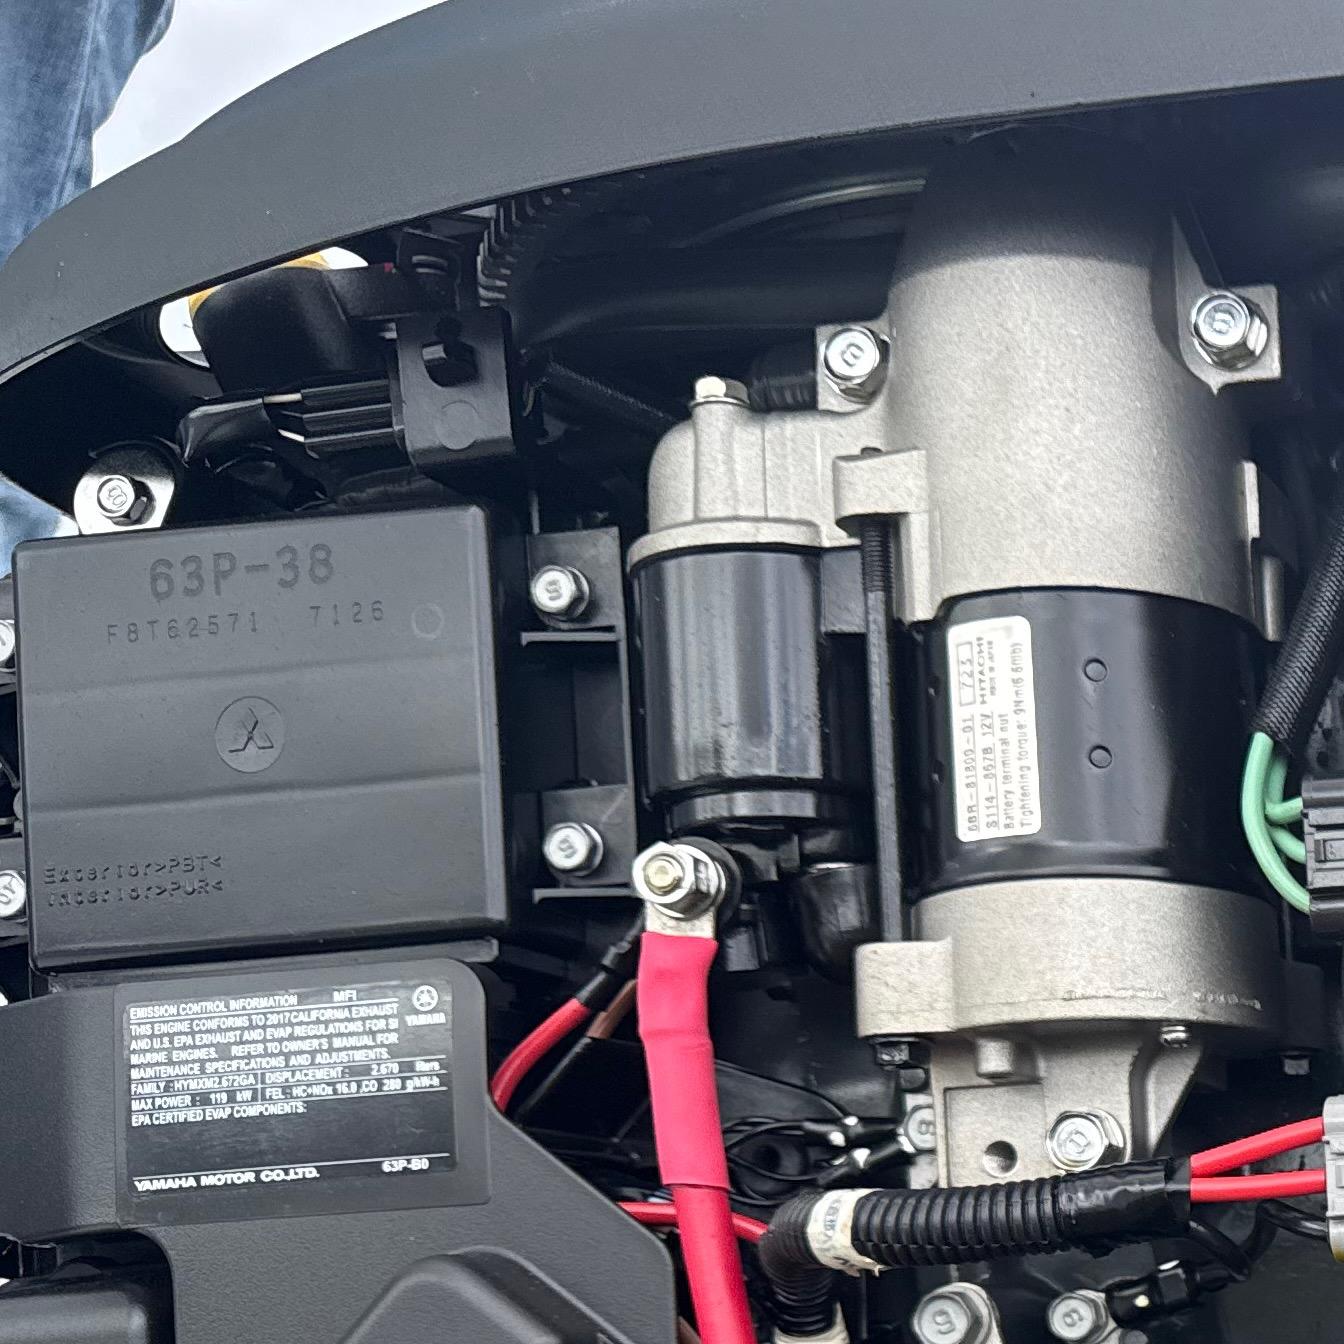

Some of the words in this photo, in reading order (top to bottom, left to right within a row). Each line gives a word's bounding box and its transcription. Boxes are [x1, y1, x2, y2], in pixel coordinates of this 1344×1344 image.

[150, 543, 333, 600] 63P-38
[976, 637, 987, 704] HITACHI
[981, 714, 993, 737] 12V
[999, 713, 1009, 731] nut
[1001, 738, 1012, 784] terminal
[1004, 790, 1015, 829] Battery
[1019, 767, 1033, 828] Tightening
[130, 1006, 177, 1019] EMISSION
[179, 1001, 227, 1015] CONTROL
[230, 995, 297, 1011] INFORMATION
[333, 990, 356, 1001] MFI
[405, 1012, 446, 1026] YAMAHA
[131, 1024, 152, 1036] THIS
[154, 1021, 191, 1034] ENGINE
[193, 1017, 249, 1031] CONFORMS
[251, 1014, 265, 1025] TO
[266, 1013, 290, 1025] 2017
[291, 1009, 350, 1023] CALIFORNIA
[352, 1004, 399, 1014] EXHAUST
[131, 1039, 151, 1050] AND
[153, 1037, 172, 1048] U.S.
[174, 1035, 193, 1047] EPA
[196, 1031, 241, 1045] EXHAUST
[243, 1029, 264, 1040] AND
[266, 1027, 293, 1039] EVAP
[294, 1021, 363, 1036] REGULATIONS
[366, 1020, 386, 1030] FOR
[388, 1018, 399, 1028] SI
[131, 1052, 168, 1065] MARINE
[173, 1048, 218, 1062] ENGINES.
[232, 1044, 264, 1057] REFER
[266, 1043, 280, 1053] TO
[282, 1038, 329, 1052] OWNER'S
[332, 1034, 375, 1048] MANUAL
[376, 1033, 399, 1044] FOR
[131, 1063, 200, 1080] MAINTENANCE
[206, 1057, 285, 1074] SPECIFICATIONS
[290, 1054, 311, 1066] AND
[316, 1048, 391, 1064] ADJUSTMENTS.
[371, 1063, 399, 1075] 2.670
[131, 1082, 166, 1095] FAMILY
[132, 1098, 153, 1111] MAX
[155, 1095, 191, 1108] POWER
[210, 1093, 227, 1104] 119
[236, 1090, 252, 1101] kW
[132, 1115, 151, 1127] EPA
[153, 1110, 203, 1125] CERTIFIED
[206, 1107, 232, 1120] EVAP
[234, 1101, 307, 1118] COMPONENTS:
[133, 1176, 197, 1192] YAMAHA
[200, 1171, 255, 1186] MOTOR
